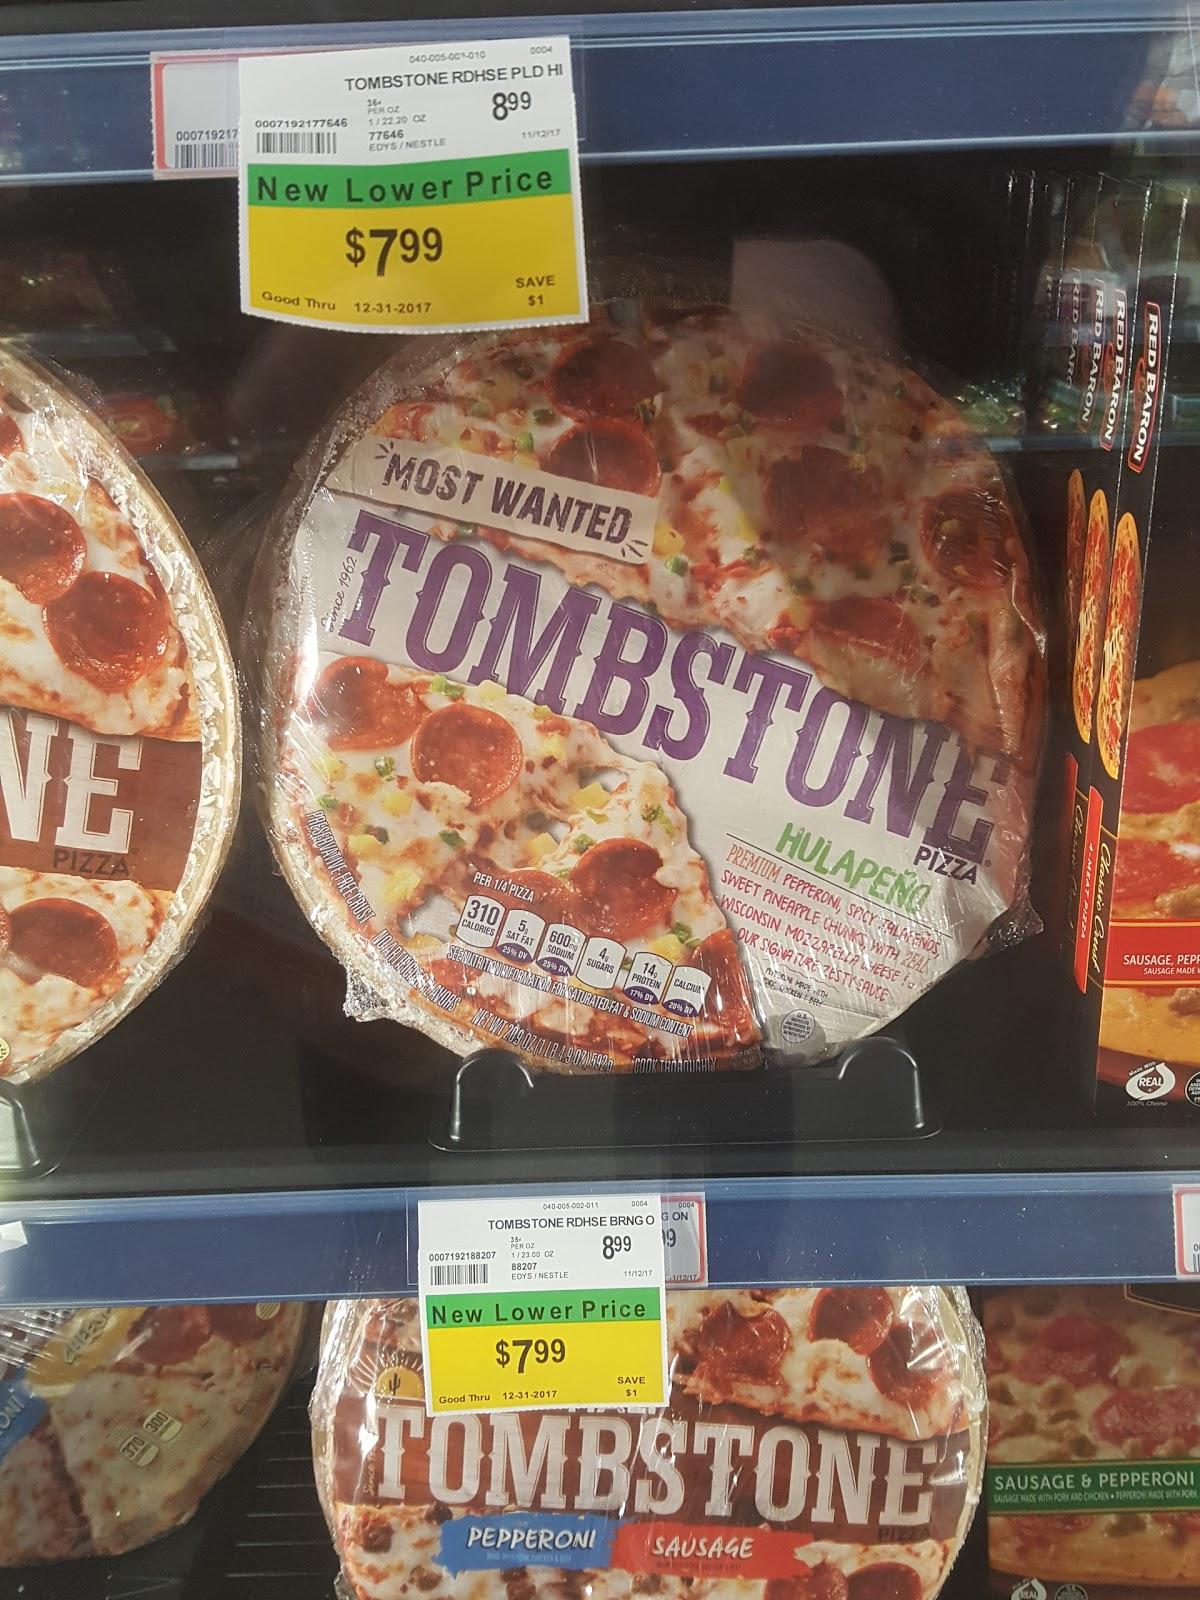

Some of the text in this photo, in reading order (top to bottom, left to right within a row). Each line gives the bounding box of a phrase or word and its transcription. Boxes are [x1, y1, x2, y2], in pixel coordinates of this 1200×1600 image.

[345, 63, 563, 91] TOMBSTONE RDHSE PLD HI
[492, 91, 532, 121] 899
[255, 117, 349, 129] 0007192177646
[369, 129, 405, 141] 77646
[405, 138, 446, 149] NESTLE
[258, 168, 553, 203] New Lower Price
[345, 226, 444, 277] $799
[515, 274, 556, 289] SAVE
[261, 290, 431, 314] Good Thru 12-31-2017
[528, 294, 544, 307] $1
[1081, 289, 1104, 422] RED BARON
[1104, 300, 1126, 441] RED BARON
[1133, 313, 1159, 462] RED BARON
[382, 452, 633, 545] MOST WANTED
[339, 556, 357, 588] 1962
[338, 509, 1012, 865] TOMBSTONE
[53, 847, 132, 878] PIZZA
[913, 846, 979, 885] PIZZA
[473, 872, 536, 902] PER 1/4 PIZZA
[726, 844, 783, 883] PREMIUM
[783, 873, 841, 916] PEPPERONI,
[847, 904, 878, 925] SPICY
[467, 900, 500, 926] 310
[720, 894, 781, 931] WISCONSIN
[721, 869, 762, 896] SWEET
[763, 889, 820, 925] PINEAPPLE
[871, 939, 900, 960] WITH
[461, 919, 496, 937] CALORIES
[506, 930, 535, 947] SAT FAT
[737, 927, 760, 947] OUR
[502, 945, 517, 956] 25%
[546, 944, 575, 960] SODIUM
[1123, 954, 1174, 966] SAUSAGE,
[542, 960, 558, 971] 25%
[586, 957, 615, 974] SUGARS
[1143, 967, 1175, 975] SAUSAGE
[631, 973, 662, 990] PROTEIN
[471, 1008, 491, 1029] NET
[489, 1014, 506, 1035] WT
[566, 985, 609, 1012] SATURATED
[608, 1001, 625, 1016] FAT
[622, 1006, 631, 1018] &
[630, 1007, 662, 1028] SODIUM
[659, 1016, 694, 1038] CONTENT
[633, 1057, 657, 1074] COOK
[1138, 1076, 1164, 1087] REAL
[488, 1215, 655, 1230] TOMBSTONE RDHSE BRNG O
[672, 1211, 688, 1221] ON
[429, 1251, 496, 1261] 0007192188207
[602, 1235, 632, 1260] 899
[512, 1262, 537, 1270] 88207
[539, 1271, 568, 1279] NESTLE
[624, 1270, 653, 1278] 11/12/17
[432, 1300, 646, 1324] New Lower Price
[496, 1338, 566, 1373] $799
[617, 1376, 646, 1385] SAVE
[439, 1390, 557, 1404] Good Thru 12-31-2017
[626, 1389, 637, 1397] $1
[145, 1411, 168, 1434] 300
[122, 1436, 145, 1458] 370
[369, 1404, 937, 1526] TOMBSTONE
[995, 1471, 1194, 1490] SAUSAGE & PEPPERONI
[467, 1526, 597, 1551] PEPPERONI
[652, 1536, 753, 1559] SAUSAGE
